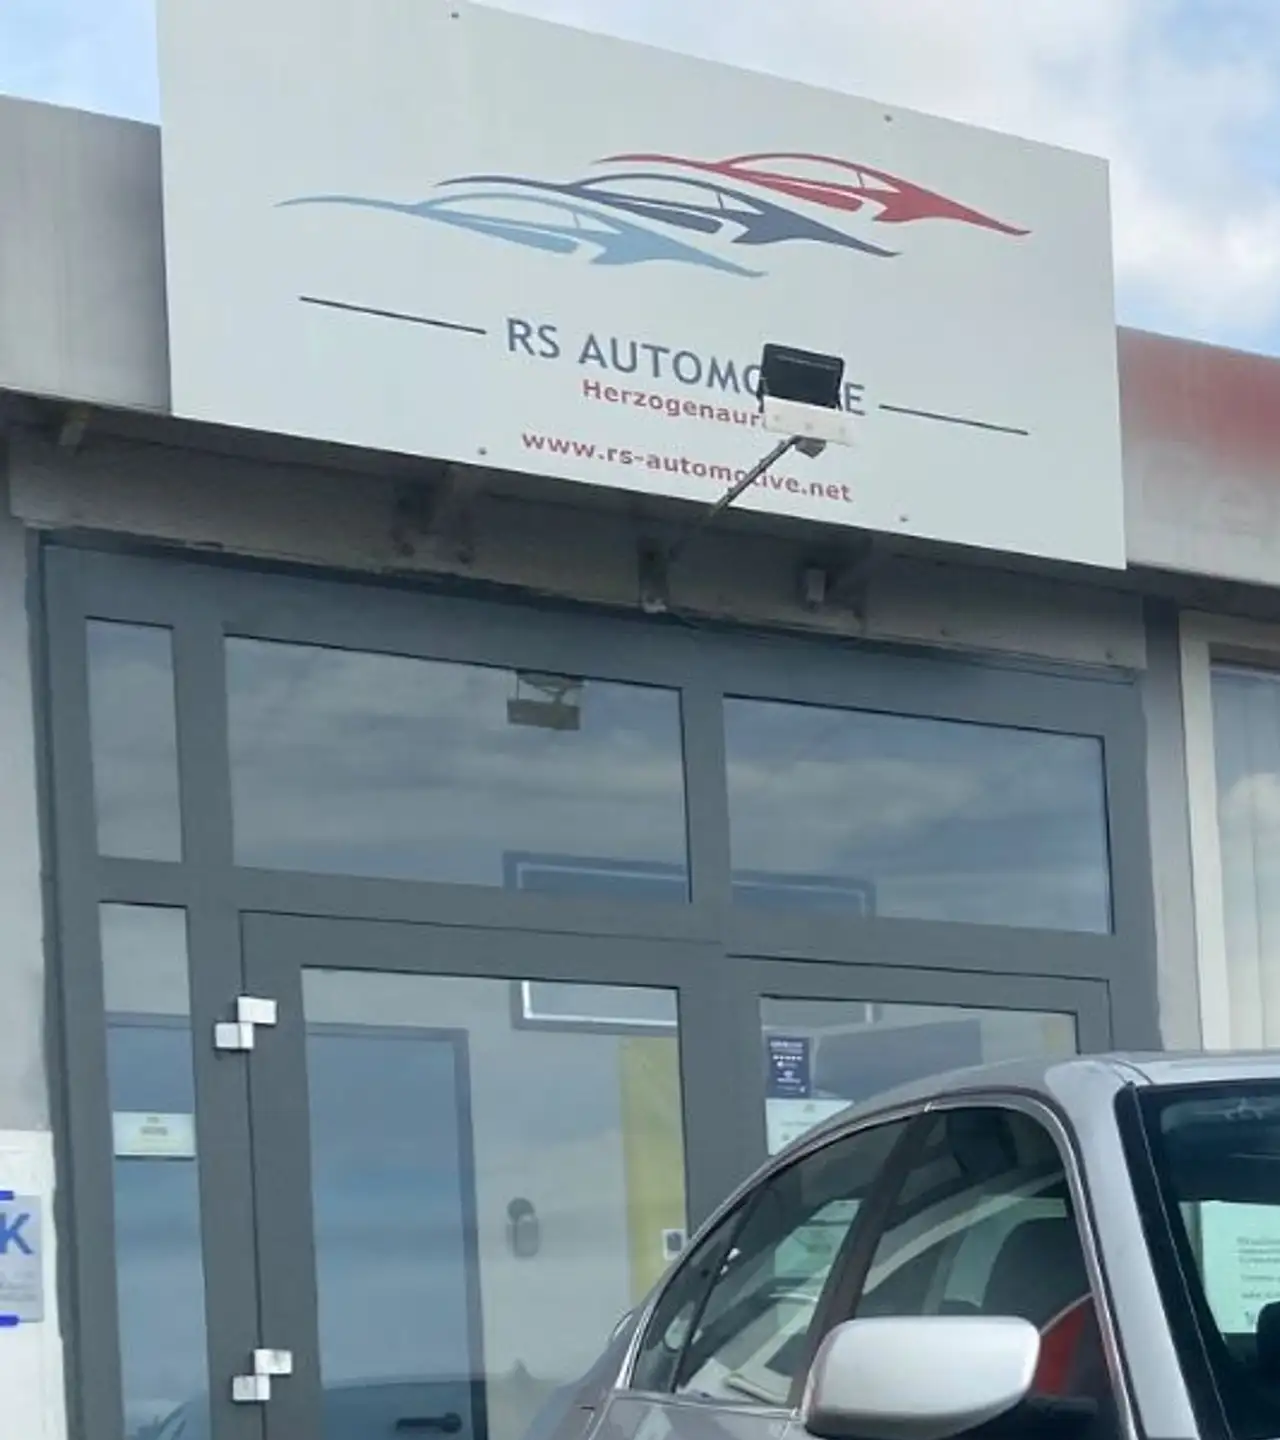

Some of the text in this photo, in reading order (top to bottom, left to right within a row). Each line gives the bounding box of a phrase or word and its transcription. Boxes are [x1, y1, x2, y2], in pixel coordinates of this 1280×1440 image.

[506, 317, 867, 417] RS AUTOMOE
[582, 378, 766, 429] Herzogenaur
[521, 431, 853, 503] www.rs-automoive.net
